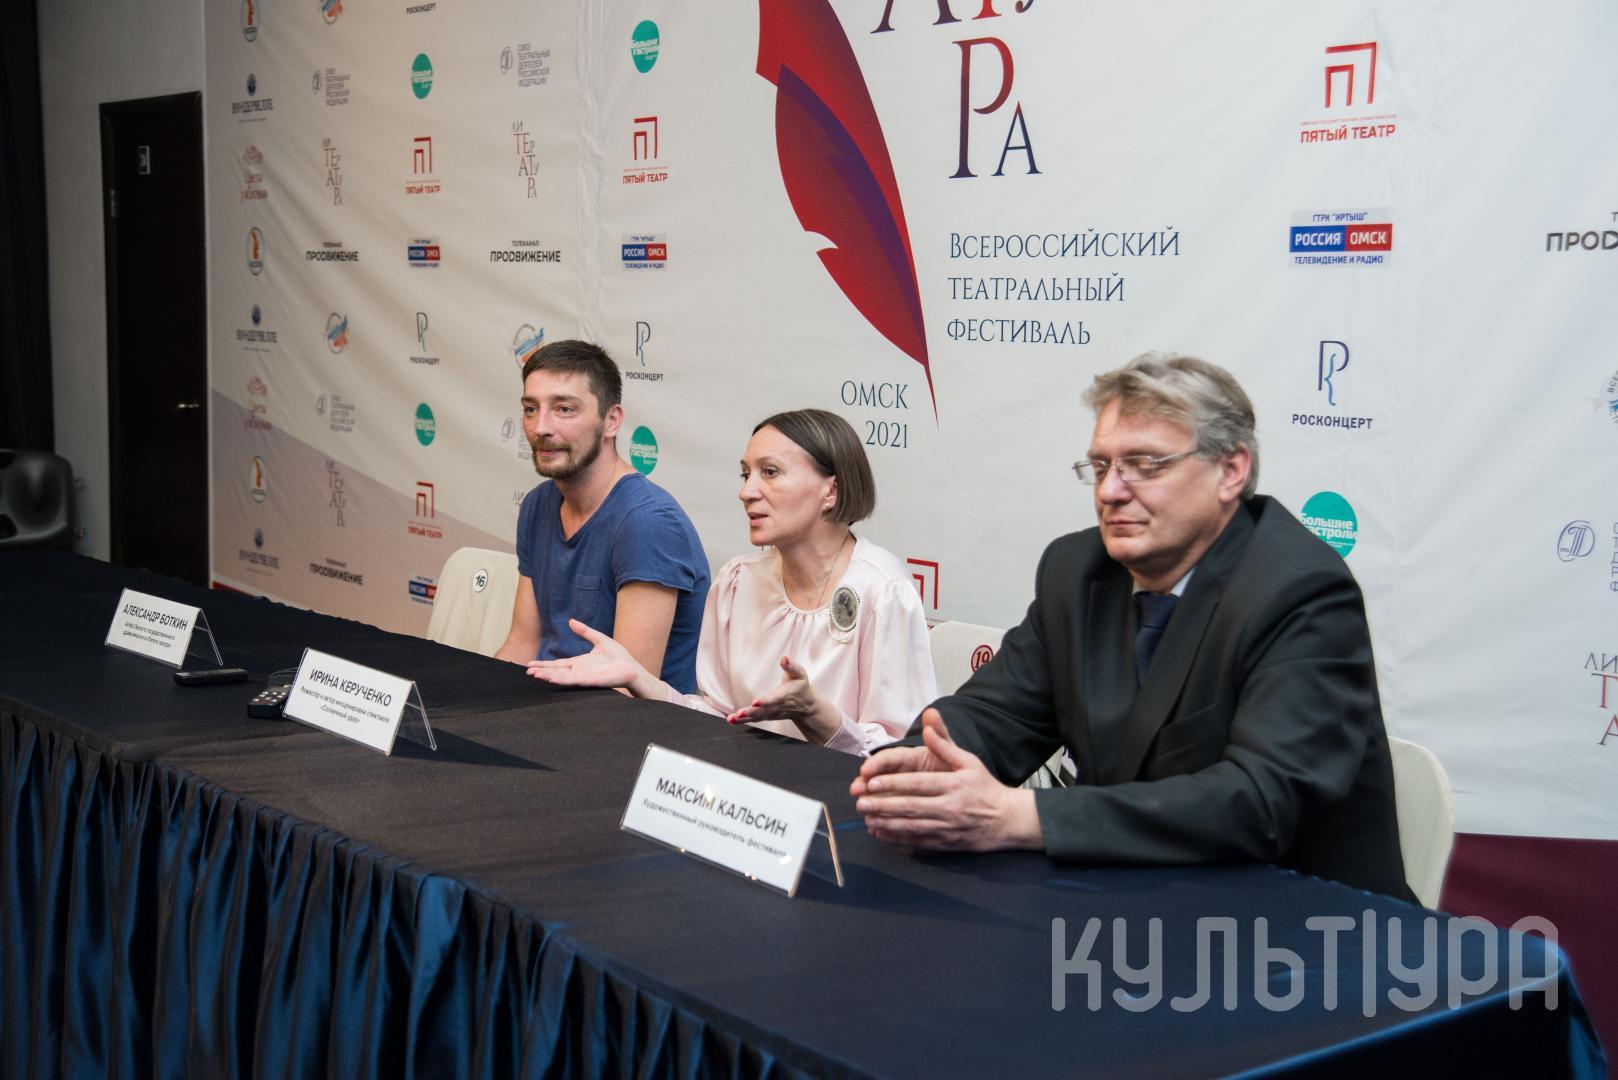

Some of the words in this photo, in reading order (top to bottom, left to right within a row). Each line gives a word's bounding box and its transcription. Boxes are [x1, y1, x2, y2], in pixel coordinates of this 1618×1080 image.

[1300, 125, 1348, 143] ПЯТЫЙ
[1351, 123, 1396, 140] ТЕАТР
[623, 172, 645, 184] ПЯТЫЙ
[647, 172, 668, 183] ТЕАТР
[1312, 213, 1330, 222] ГТРК
[949, 226, 1181, 258] ВСЕРОССИЙСКИЙ
[1294, 231, 1341, 246] РОССИЯ
[1349, 230, 1387, 245] ОМСК
[1294, 255, 1348, 265] ТЕЛЕВИДЕНИЕ
[1356, 255, 1383, 265] РАДИО
[947, 272, 1125, 302] ТЕАТРАЛЬНЫЙ
[946, 318, 1091, 345] ФЕСТИВАЛЬ
[626, 371, 664, 382] РОСКОНЦЕРТ
[840, 380, 910, 410] ОМСК
[1291, 413, 1373, 430] РОСКОНЦЕРТ
[865, 420, 908, 449] 2021
[475, 575, 485, 587] 16
[122, 604, 160, 624] АЛЕКСАНДР
[160, 613, 188, 630] БОТКИН
[309, 668, 340, 690] ИРИНА
[340, 678, 392, 707] КЕРУЧЕНКО
[655, 777, 717, 812] МАКСИМ
[716, 799, 788, 838] КАЛЬСИН
